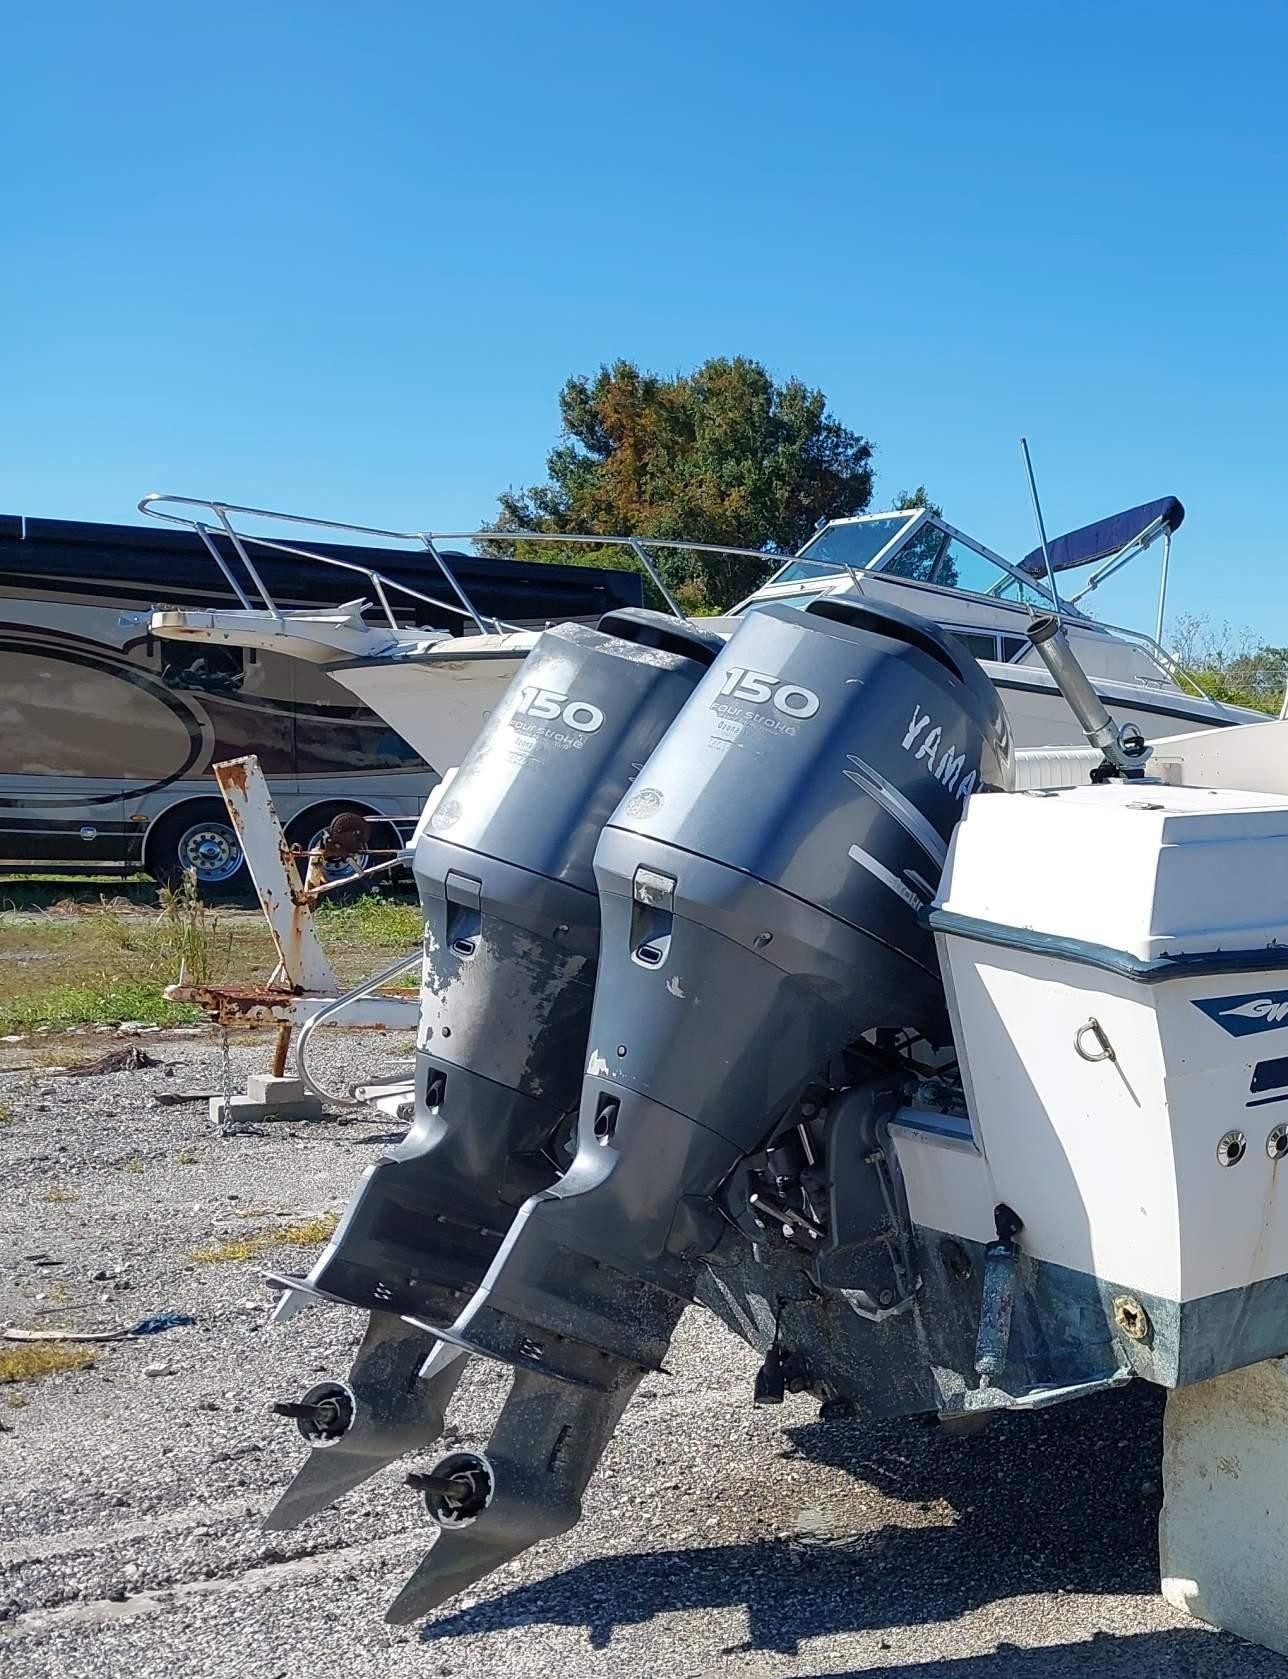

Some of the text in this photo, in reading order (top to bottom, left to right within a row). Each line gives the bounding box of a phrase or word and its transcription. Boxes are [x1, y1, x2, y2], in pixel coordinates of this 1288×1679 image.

[521, 686, 604, 733] 150
[720, 666, 820, 720] 150
[902, 704, 980, 802] YAMA
